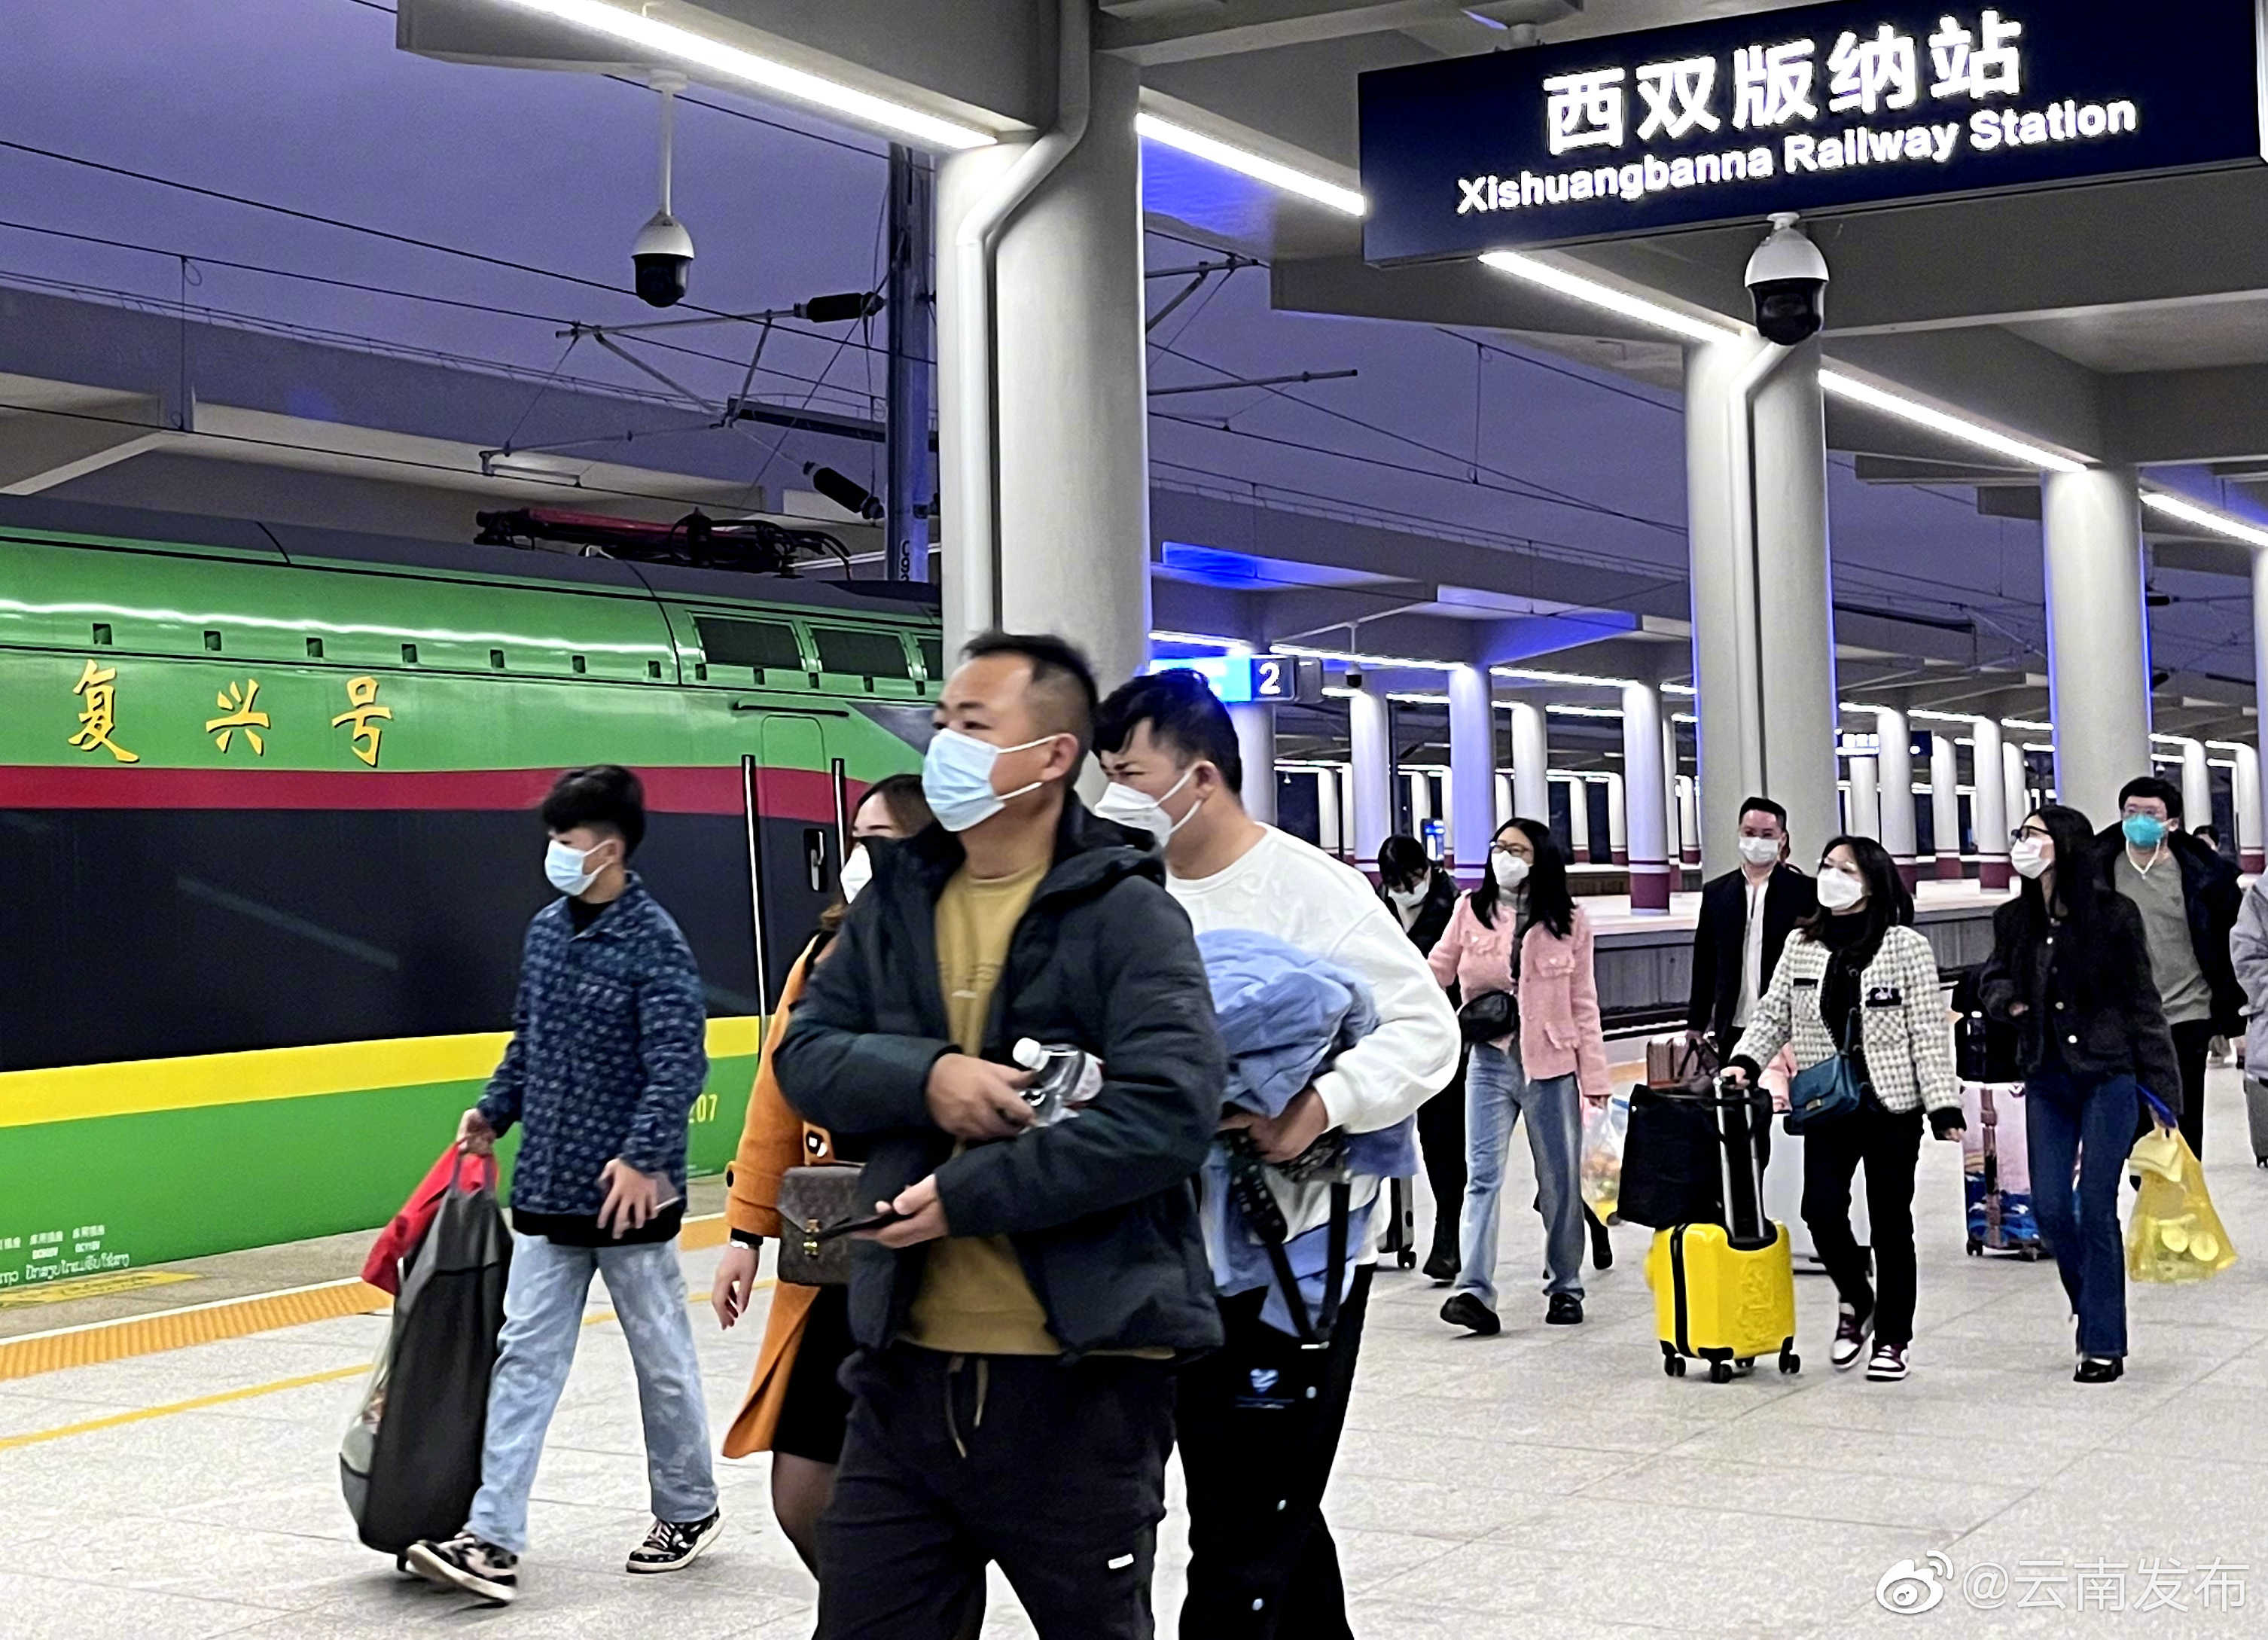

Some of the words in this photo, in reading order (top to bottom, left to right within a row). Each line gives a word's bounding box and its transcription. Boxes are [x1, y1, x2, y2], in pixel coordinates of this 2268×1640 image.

[1542, 9, 2024, 157] 西双版纳站
[1456, 146, 1775, 215] Xishuangbanna
[1784, 123, 1960, 174] Railway
[1968, 99, 2136, 151] Station
[68, 659, 394, 767] 复兴号
[1259, 662, 1281, 694] 2
